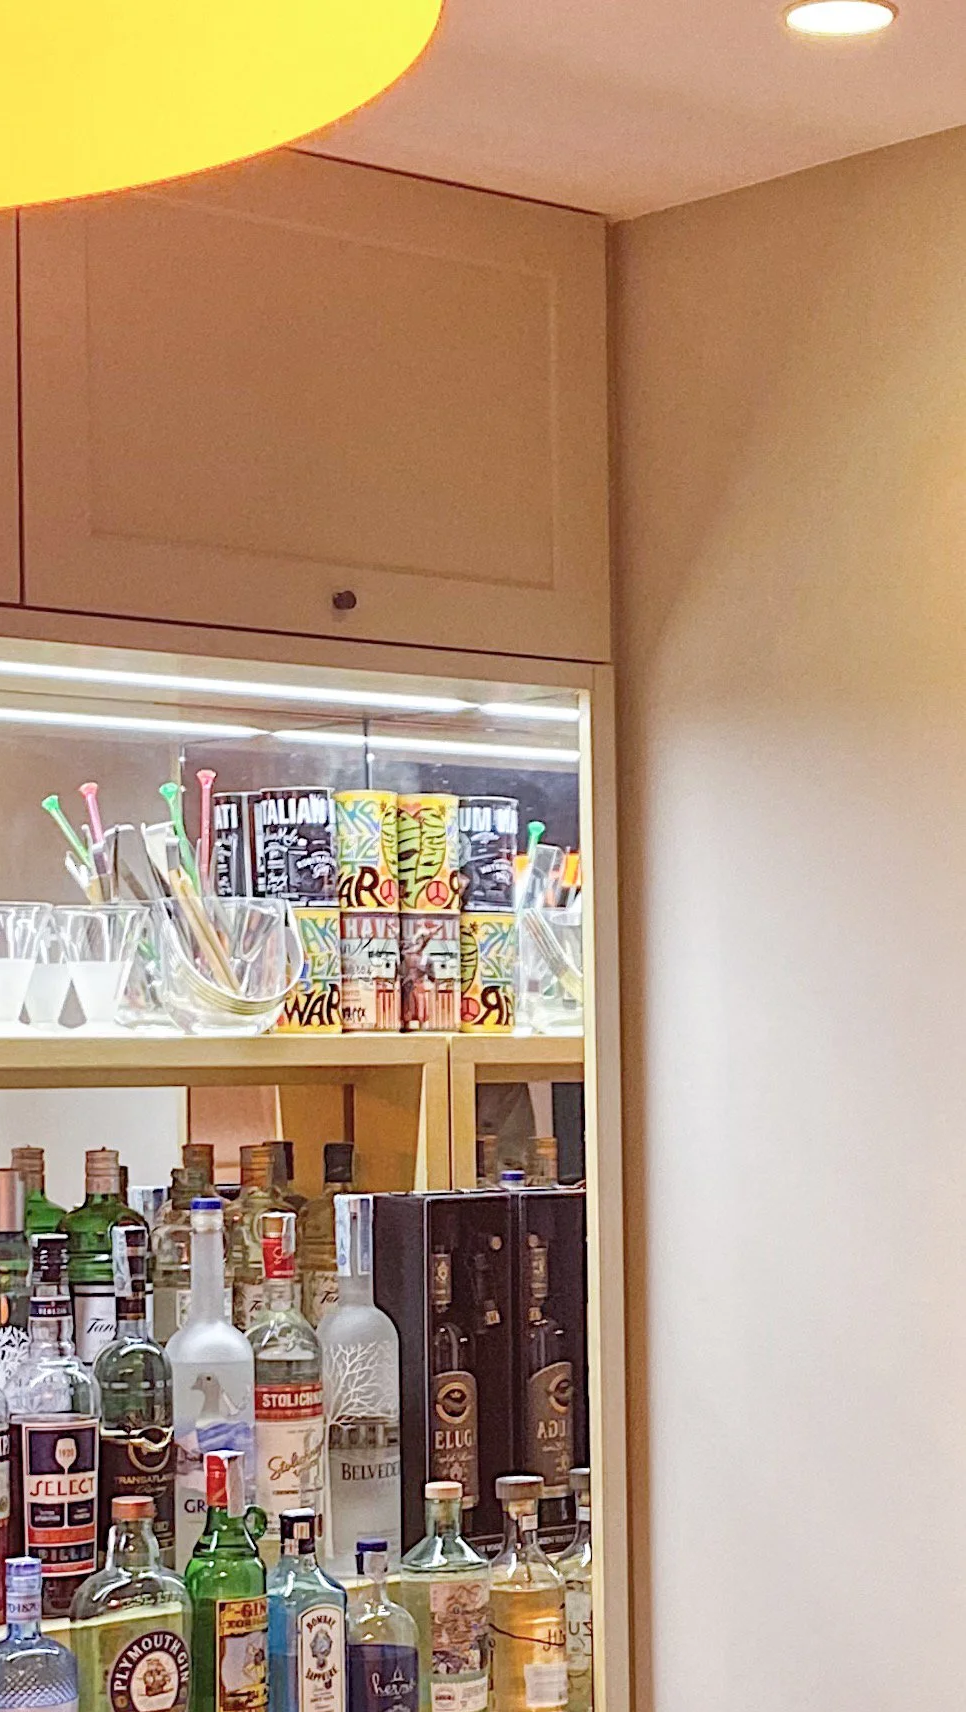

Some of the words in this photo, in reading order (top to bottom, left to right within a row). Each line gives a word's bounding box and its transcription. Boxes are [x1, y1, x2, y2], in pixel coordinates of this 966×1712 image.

[338, 866, 387, 907] AR
[30, 1476, 94, 1496] SELECT
[305, 1615, 337, 1633] BOMBAY
[113, 1634, 179, 1692] PLYMOUTH
[178, 1650, 190, 1684] GIN
[305, 1663, 339, 1682] SAPPHIRE
